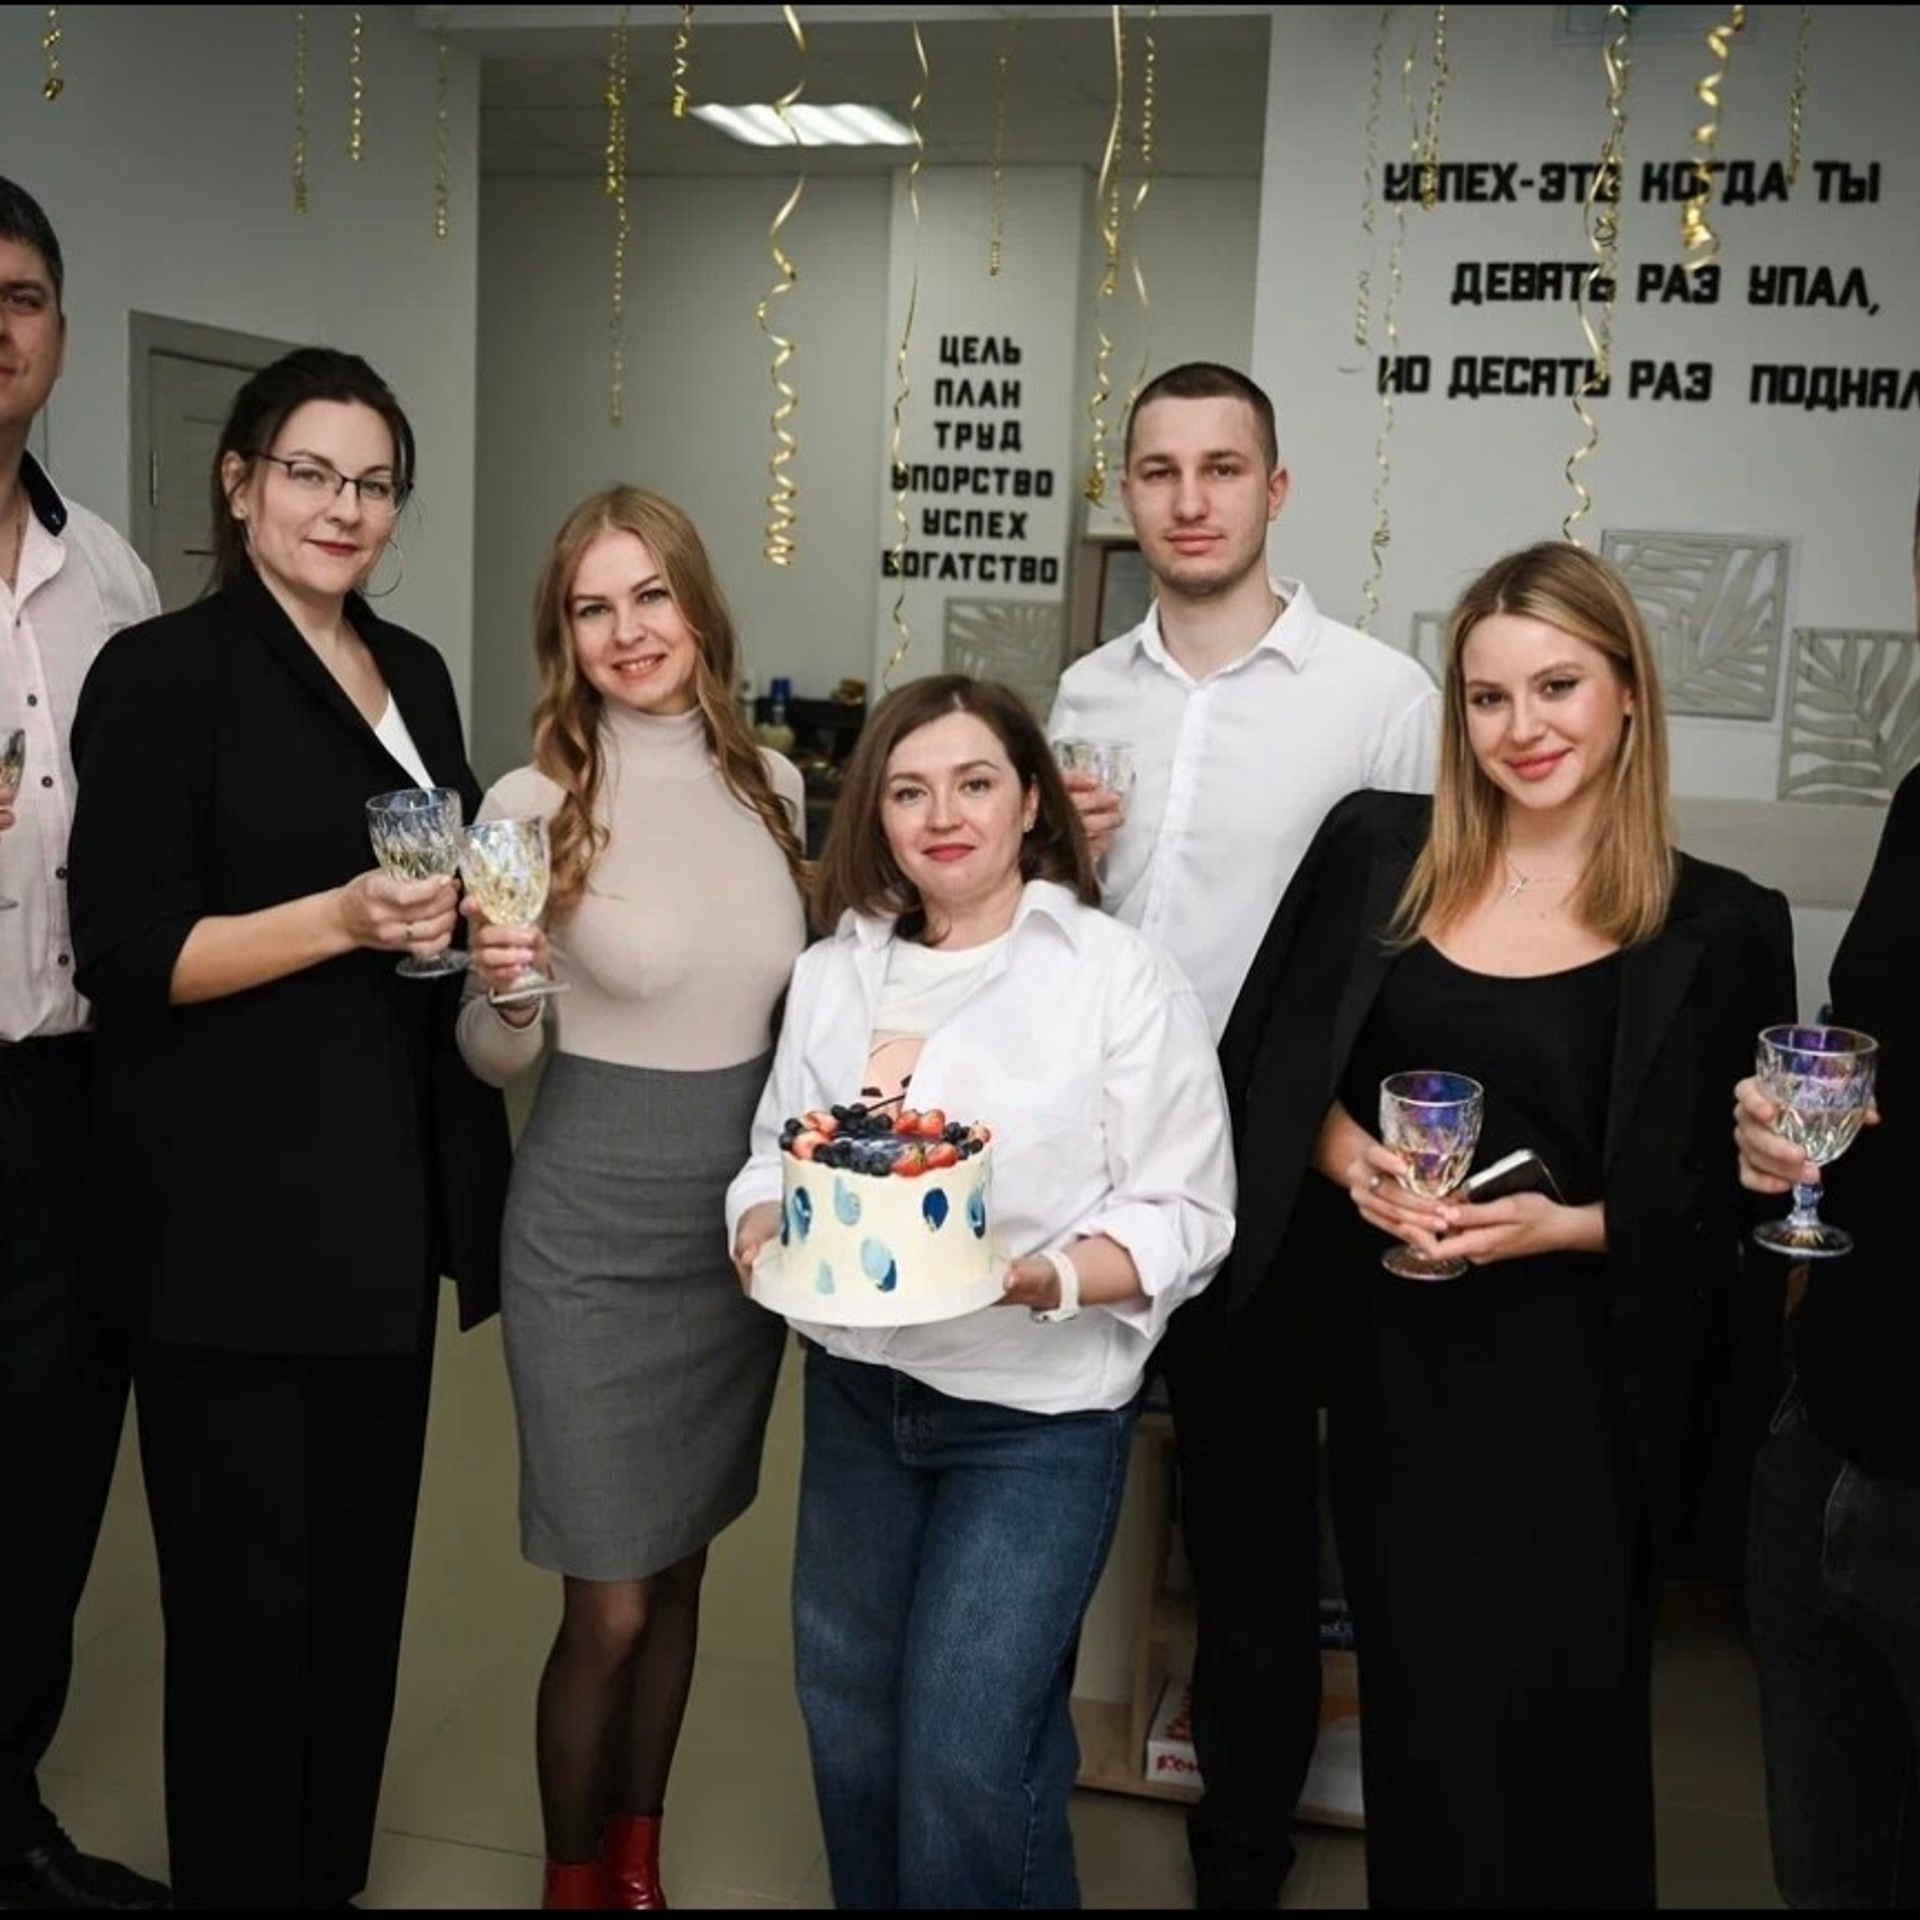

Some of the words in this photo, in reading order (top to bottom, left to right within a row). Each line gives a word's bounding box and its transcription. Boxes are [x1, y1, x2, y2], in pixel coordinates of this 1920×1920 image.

[1641, 161, 1788, 206] КОГДА
[1812, 161, 1881, 204] ТЫ
[1451, 262, 1615, 305] ДЕВЯТЬ
[1637, 264, 1721, 304] РАЗ
[1748, 266, 1880, 316] УПАЛ,
[940, 336, 1021, 367] ЦЕЛЬ
[935, 379, 1021, 408] ПЛАН
[1448, 357, 1610, 399] ДЕСЯТЬ
[1629, 360, 1712, 402] РАЗ
[934, 421, 1022, 452] ТРУД
[891, 464, 1053, 497] УПОРСТВО
[922, 508, 1027, 540] УСПЕХ
[882, 550, 1058, 584] БОГАТСТВО
